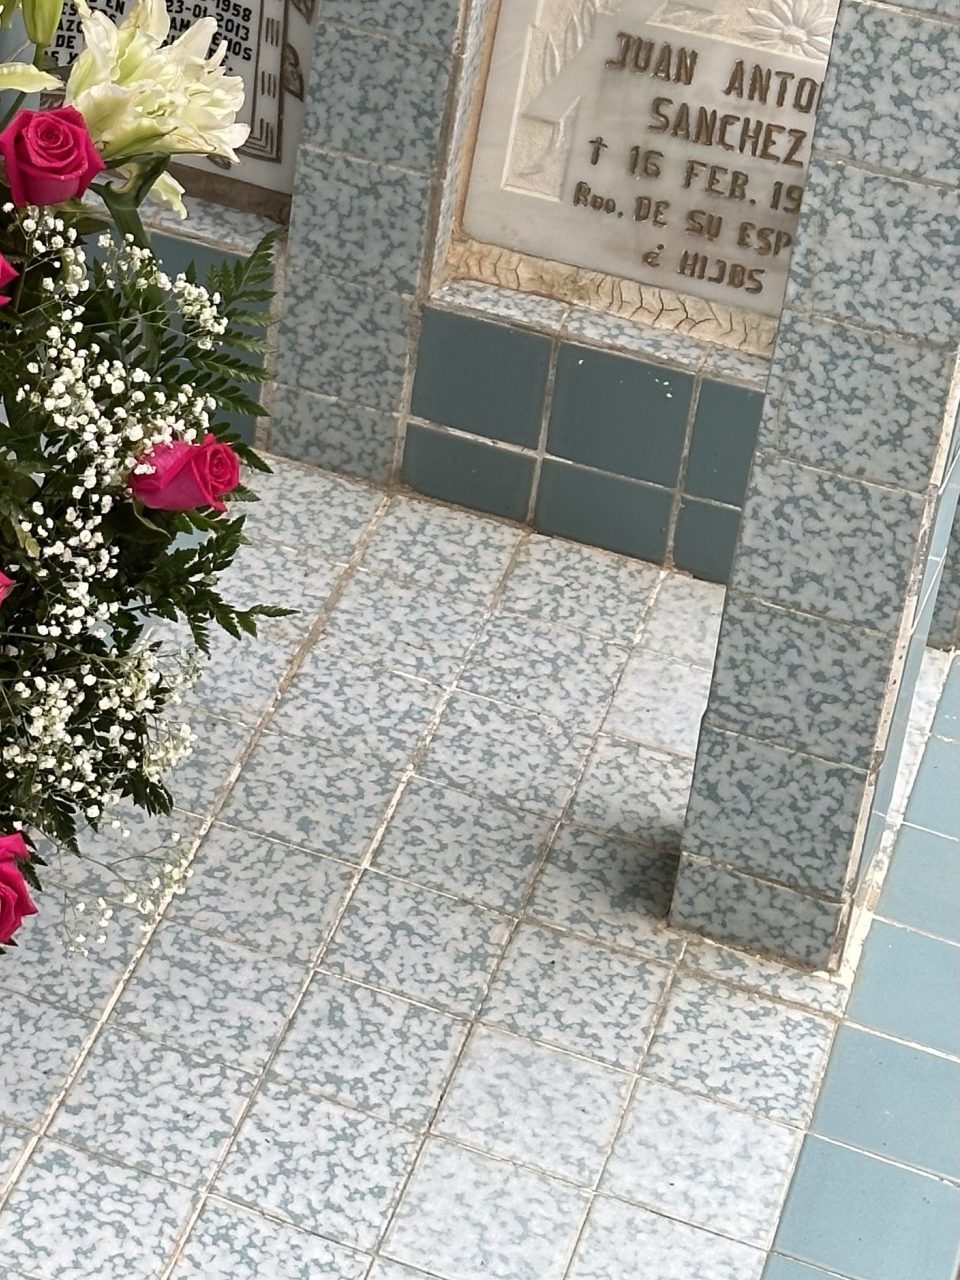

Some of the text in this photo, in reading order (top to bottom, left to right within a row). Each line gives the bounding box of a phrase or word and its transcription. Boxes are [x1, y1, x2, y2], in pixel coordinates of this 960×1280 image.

[605, 31, 826, 117] JUAN ANTO
[647, 96, 807, 168] SANCHEZ
[629, 145, 665, 178] 16
[681, 158, 756, 206] FEB.
[634, 195, 670, 228] DE
[686, 208, 723, 242] SU
[678, 249, 766, 295] HIJOS
